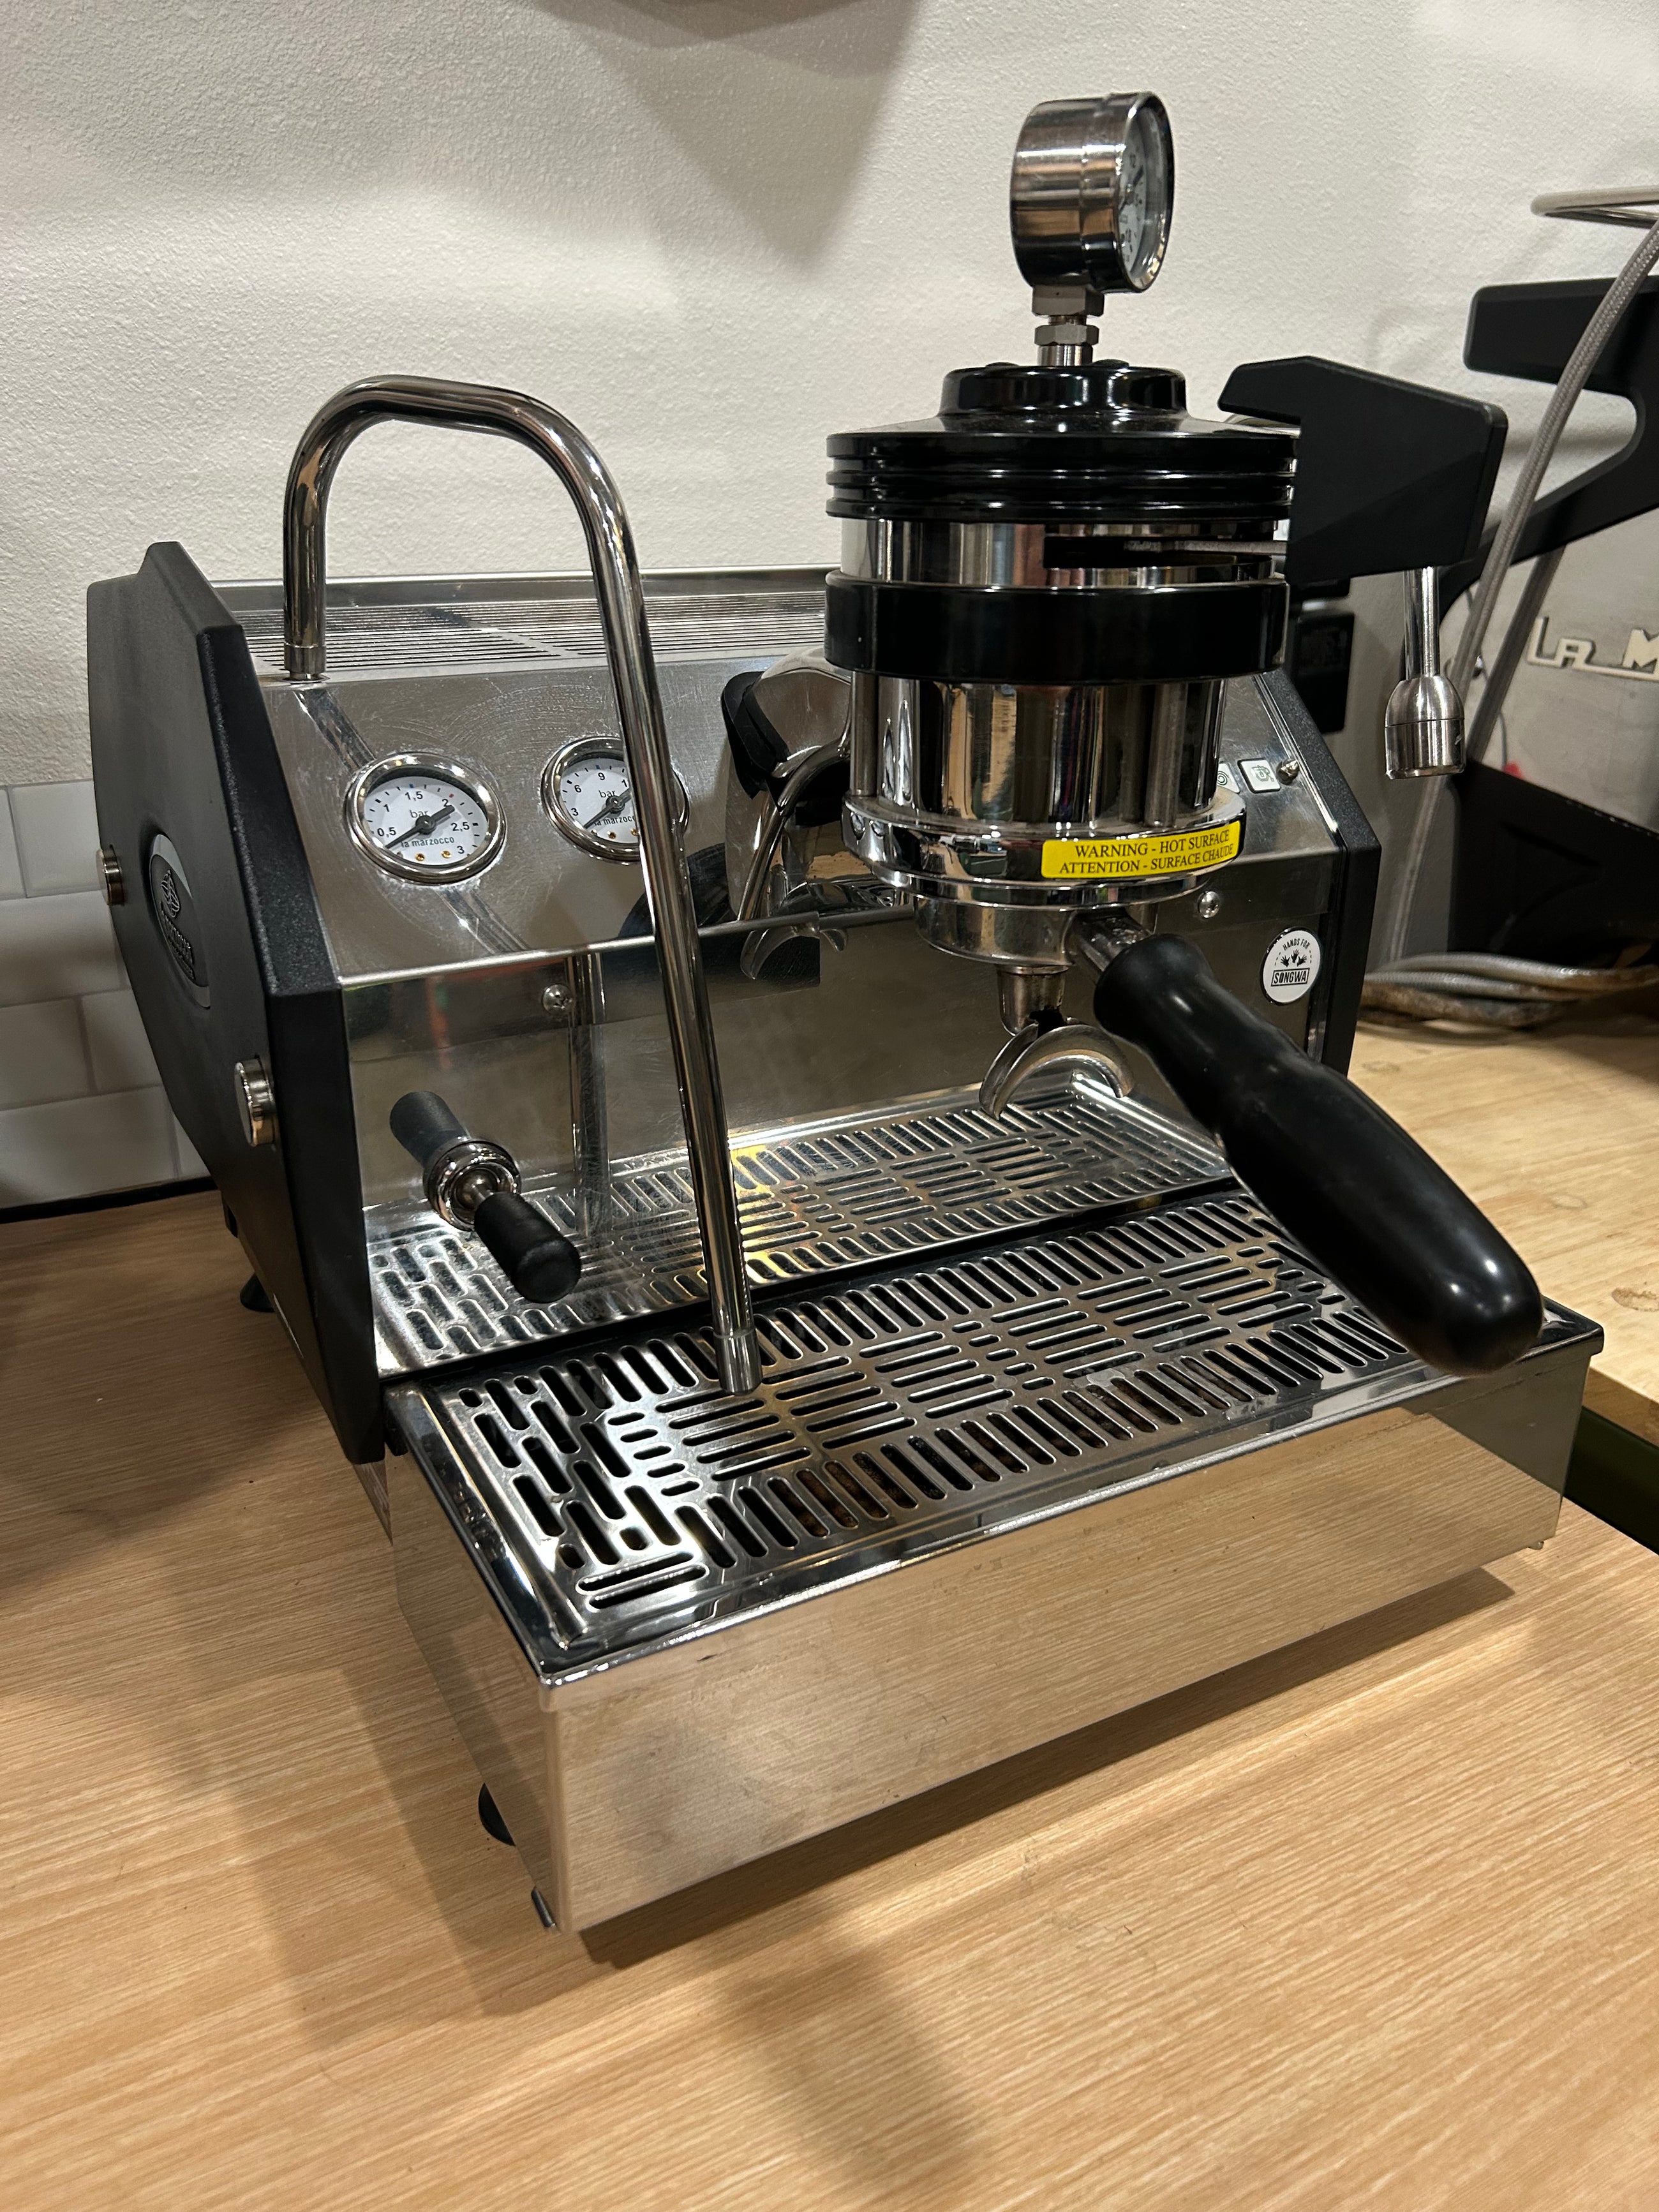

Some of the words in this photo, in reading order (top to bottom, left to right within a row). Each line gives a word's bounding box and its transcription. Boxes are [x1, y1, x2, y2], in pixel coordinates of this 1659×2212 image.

[598, 772, 606, 781] 9
[574, 784, 582, 793] 6
[405, 791, 424, 802] 1,5
[598, 790, 616, 798] bar
[442, 798, 449, 807] 2
[383, 803, 391, 813] 1
[570, 808, 579, 817] 3
[409, 809, 428, 819] bar
[603, 815, 636, 825] marzoc
[450, 821, 470, 832] 2,5
[376, 827, 397, 838] 0,5
[412, 836, 455, 847] marzocco
[1075, 842, 1148, 857] WARNING
[1159, 838, 1186, 854] HOT
[1188, 829, 1230, 850] SURFACE
[456, 845, 465, 854] 3
[1059, 859, 1140, 874] ATTENTION
[1150, 852, 1201, 870] SURFACE
[1202, 843, 1234, 862] CHAUDE
[1283, 938, 1300, 951] HANDS
[1300, 939, 1311, 949] FOR
[1274, 970, 1307, 984] SONGWA
